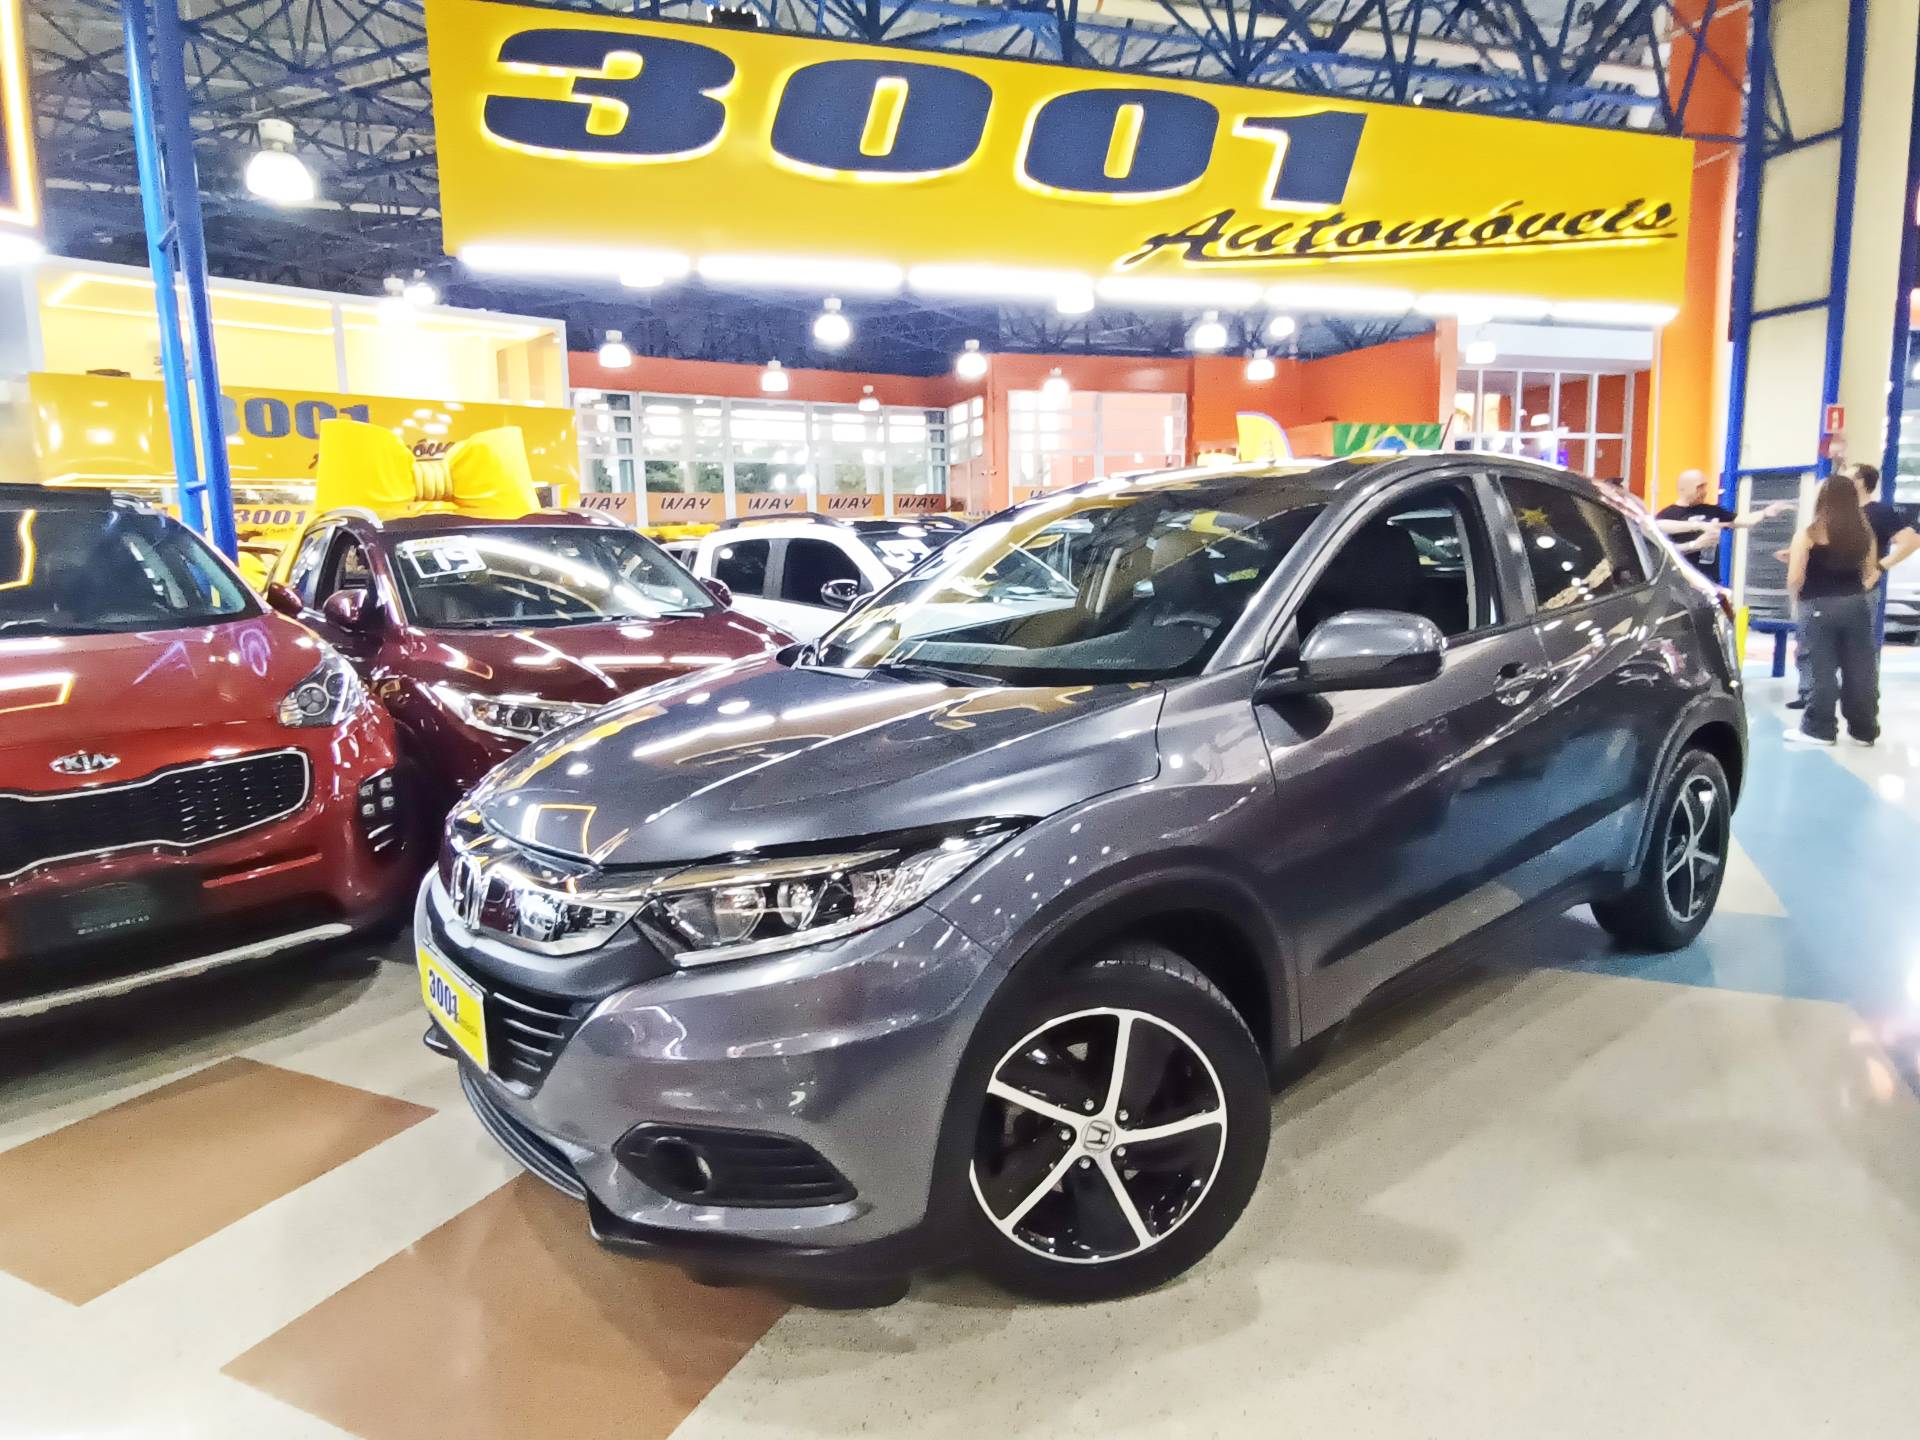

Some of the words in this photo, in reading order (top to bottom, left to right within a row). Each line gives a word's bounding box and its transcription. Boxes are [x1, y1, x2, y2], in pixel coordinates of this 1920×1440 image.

[484, 28, 1368, 204] 3001
[1120, 197, 1678, 265] Automóveis
[661, 497, 711, 510] WAY
[748, 497, 794, 510] WAY
[828, 496, 872, 509] WAY
[898, 496, 940, 509] WAY
[429, 969, 460, 1023] 3001
